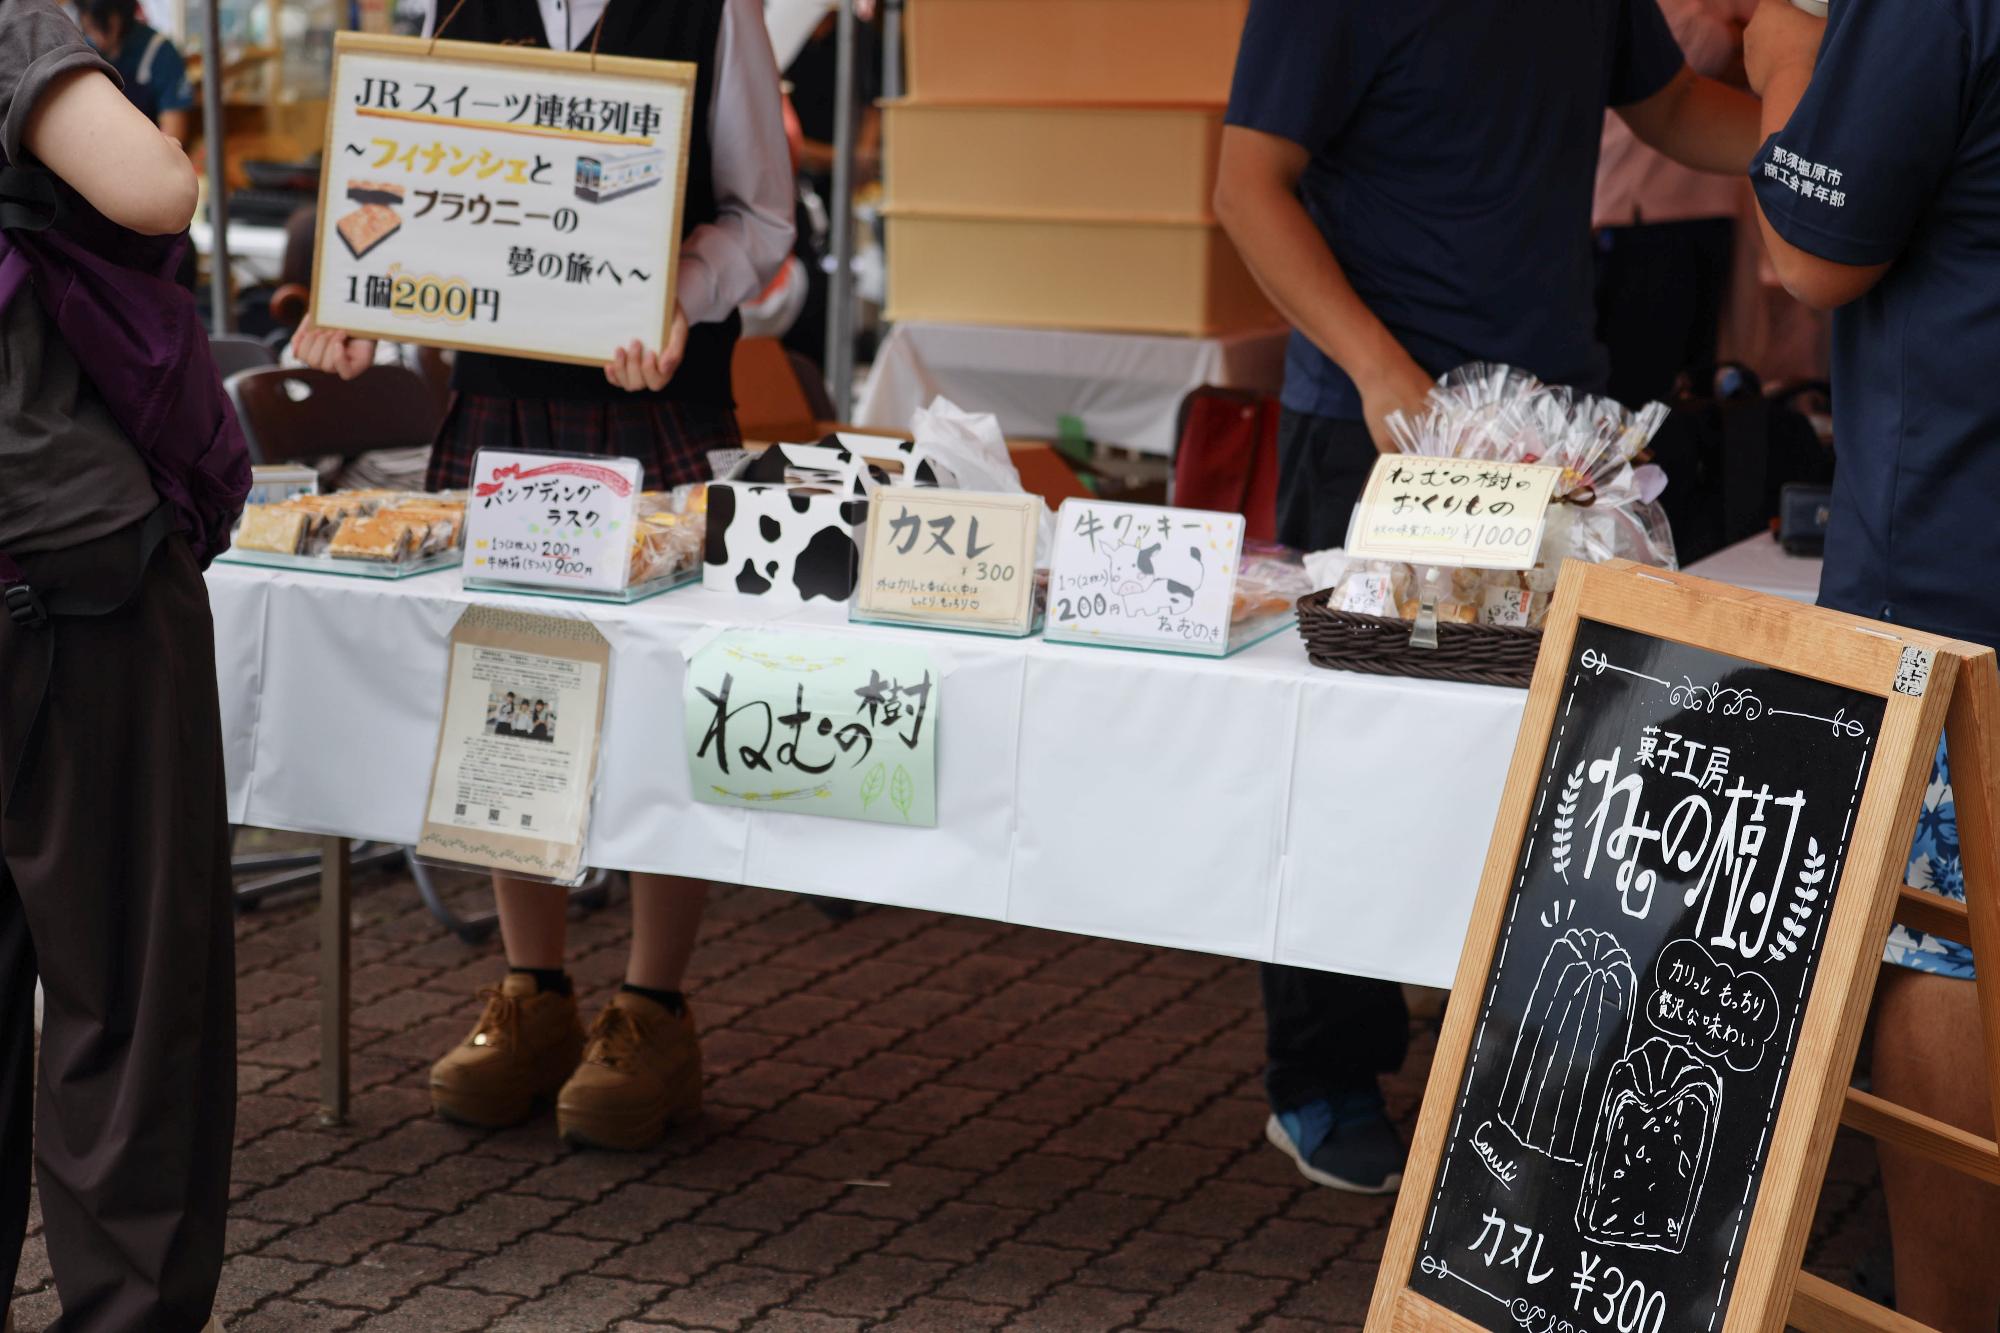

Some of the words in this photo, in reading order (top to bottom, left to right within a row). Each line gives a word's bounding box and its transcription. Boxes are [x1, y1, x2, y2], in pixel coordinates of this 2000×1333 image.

[354, 77, 400, 109] JR
[413, 82, 662, 137] スイーツ連結列車
[1764, 162, 1846, 208] 商工会青年部
[1772, 145, 1843, 186] 那須塩原市
[413, 190, 578, 233] ブラウニーの
[345, 274, 500, 322] 1個200円
[1385, 467, 1532, 491] ねむの樹の
[547, 510, 601, 528] ラスク
[1392, 491, 1515, 517] おくりもの
[887, 505, 995, 560] カヌレ
[1073, 509, 1200, 553] 牛クッキー
[1057, 593, 1120, 621] 200円
[1158, 615, 1219, 642] ねむのき
[695, 669, 932, 775] ねむの樹
[1633, 726, 1731, 796] 菓子工房
[1659, 989, 1754, 1047] 贅沢な味わい
[1719, 983, 1765, 1021] もっちり
[1468, 1208, 1554, 1284] カヌレ
